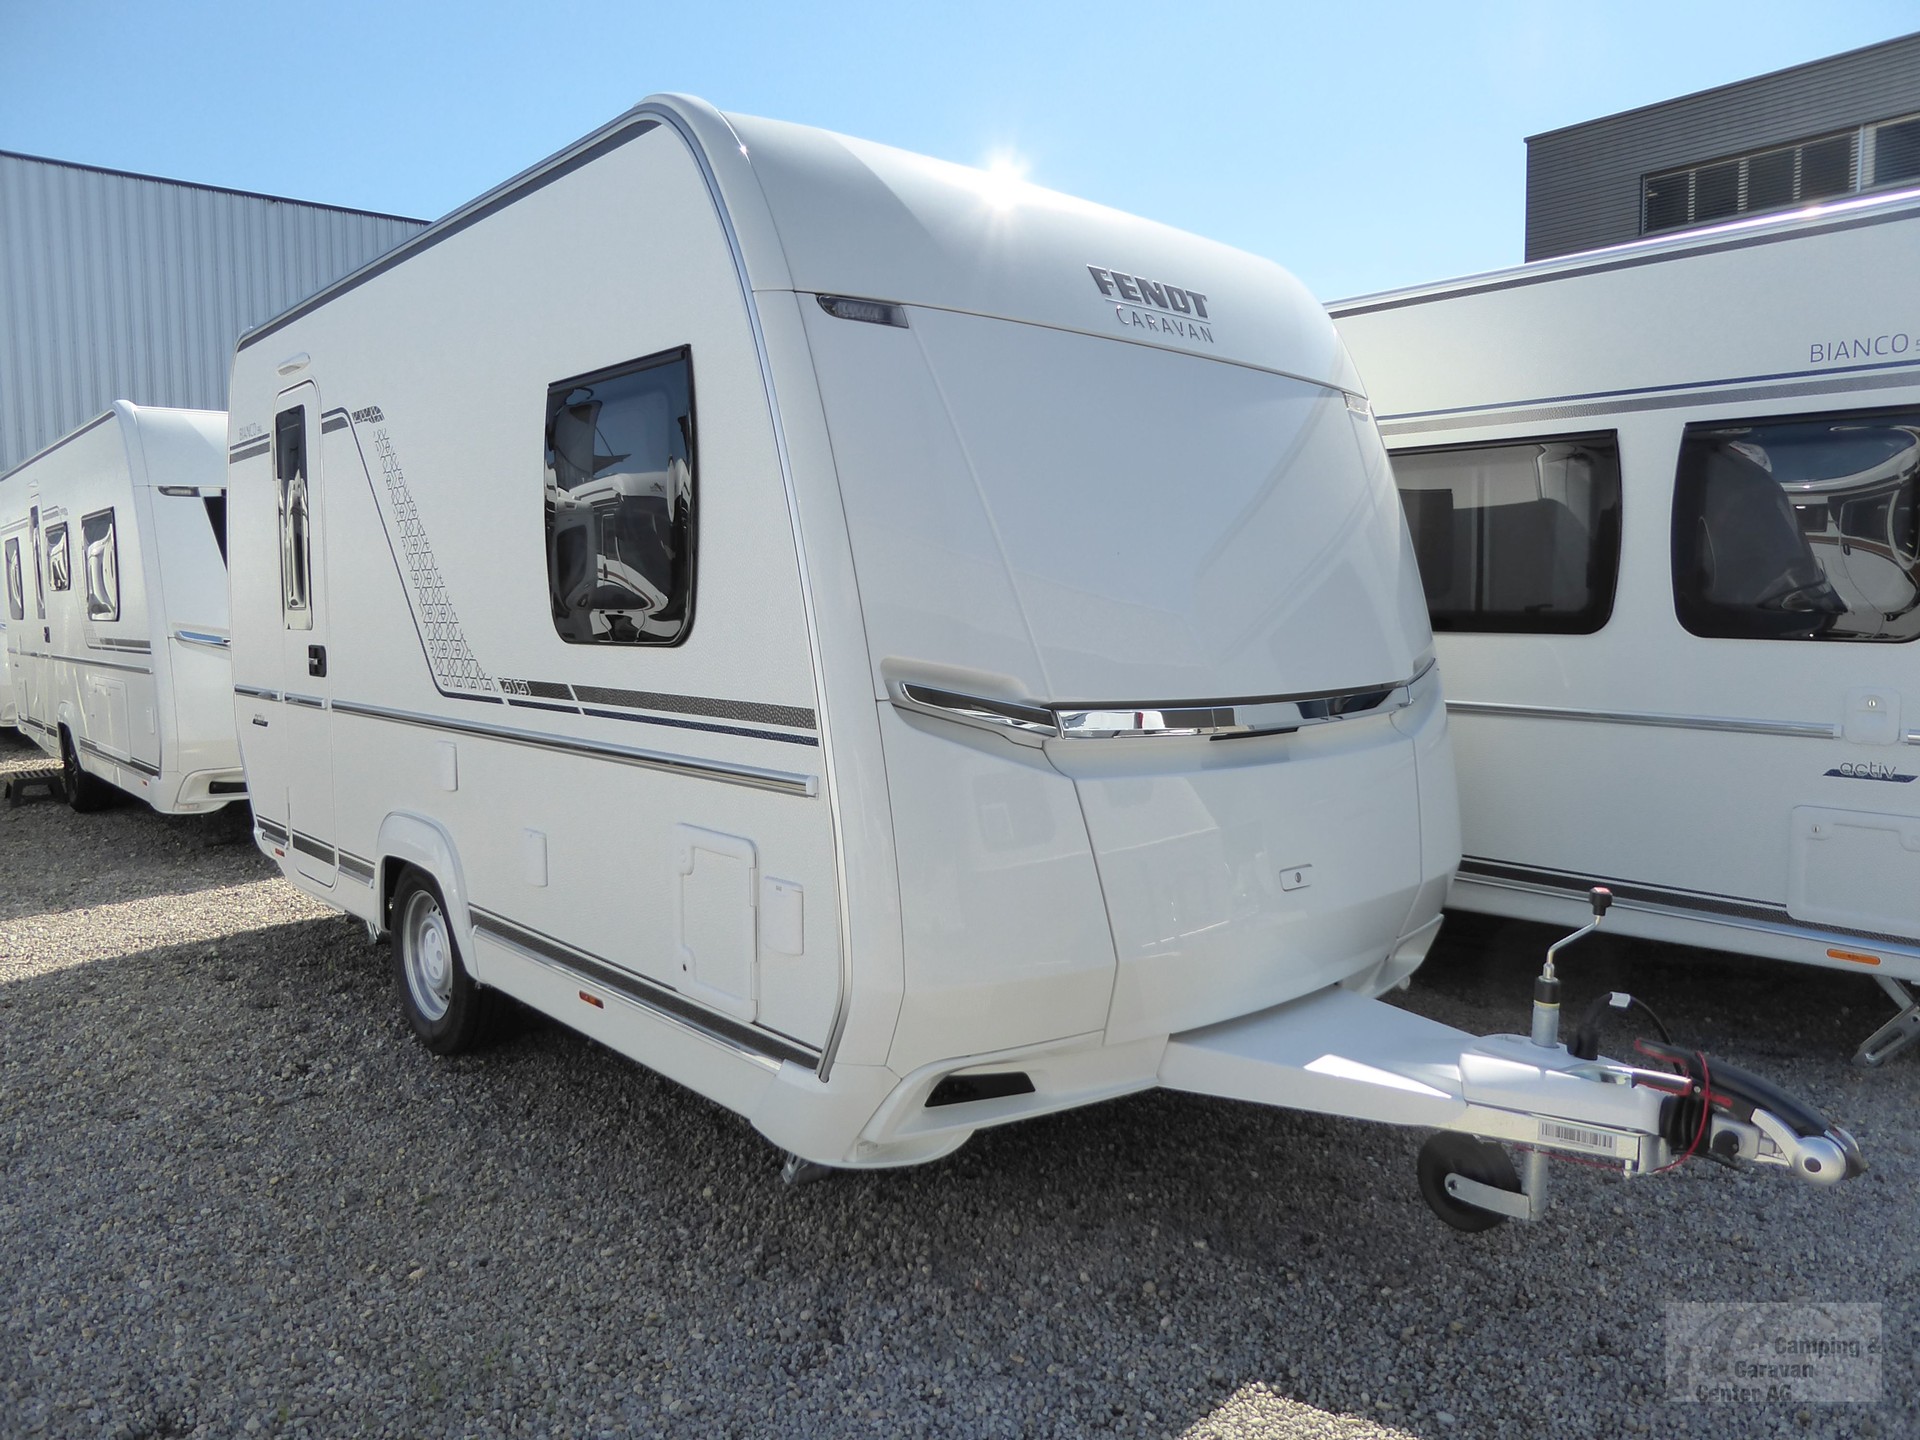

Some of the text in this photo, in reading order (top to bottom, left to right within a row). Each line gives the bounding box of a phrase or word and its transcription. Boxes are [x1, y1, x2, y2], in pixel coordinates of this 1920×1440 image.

[1086, 264, 1208, 319] FENDT
[1116, 304, 1214, 344] CARAVAN
[1810, 333, 1909, 363] BIANCO
[1840, 761, 1896, 779] activ
